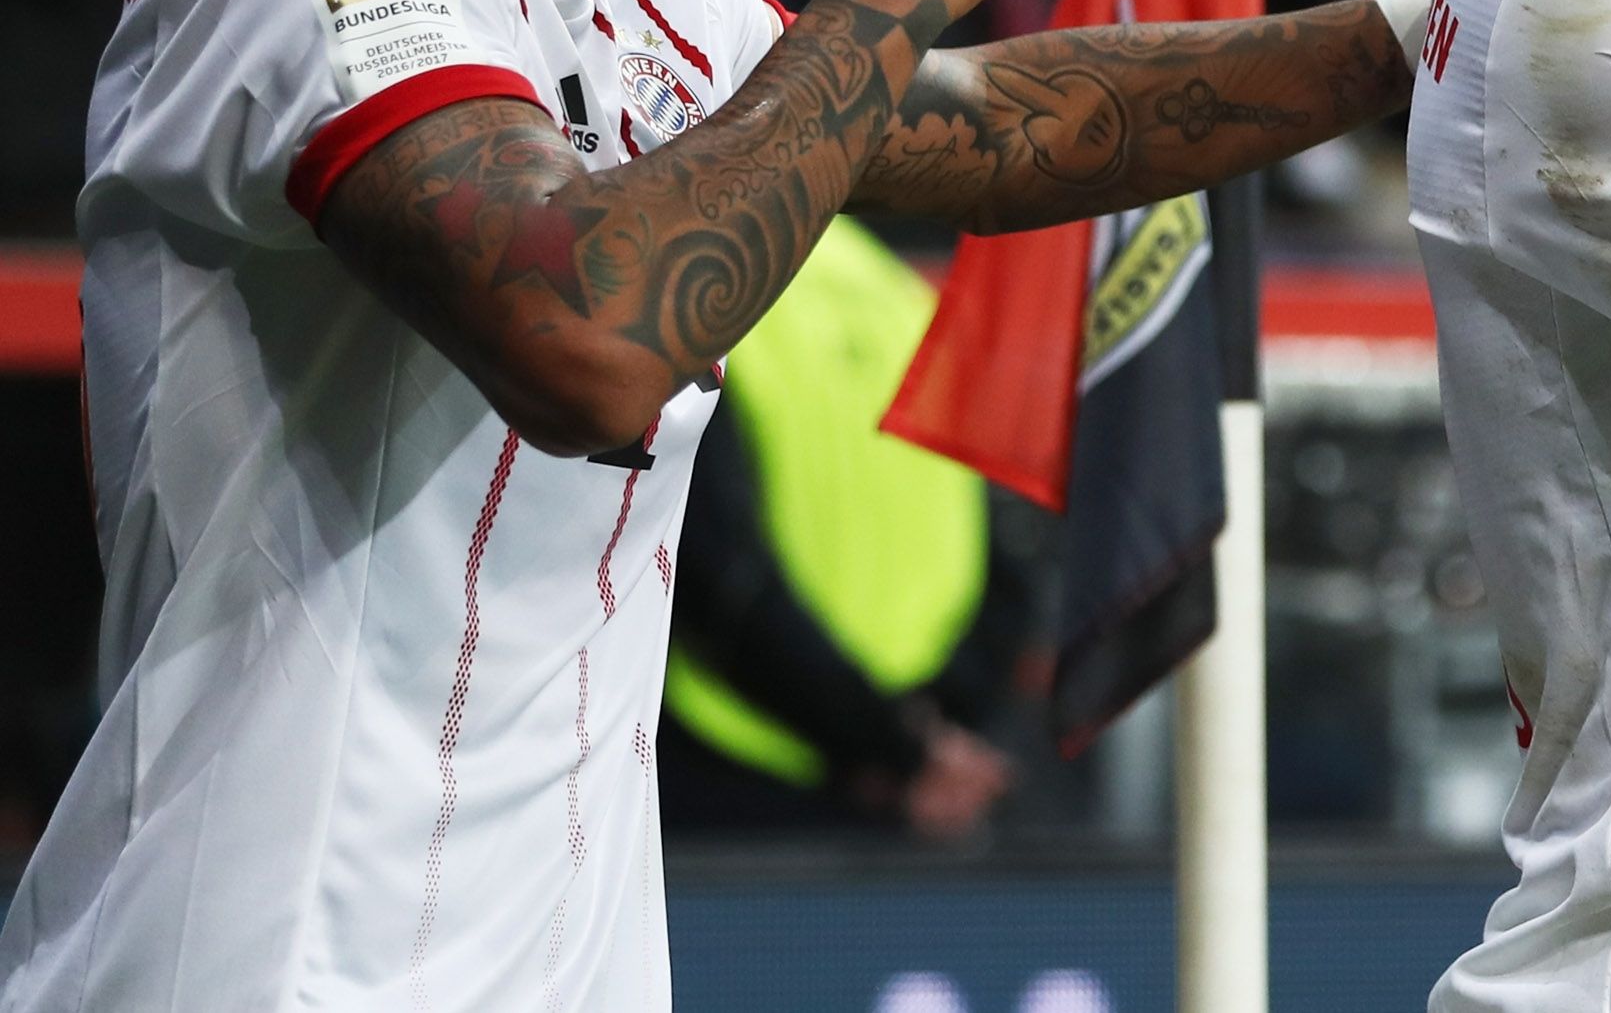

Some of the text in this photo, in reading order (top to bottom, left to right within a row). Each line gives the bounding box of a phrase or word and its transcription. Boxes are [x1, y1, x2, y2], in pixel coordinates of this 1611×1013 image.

[334, 0, 451, 33] BUNDESLIGA
[346, 42, 468, 75] FUSSBALLMEISTER
[366, 32, 444, 58] DEUTSCHER
[377, 53, 449, 79] 2016/2017
